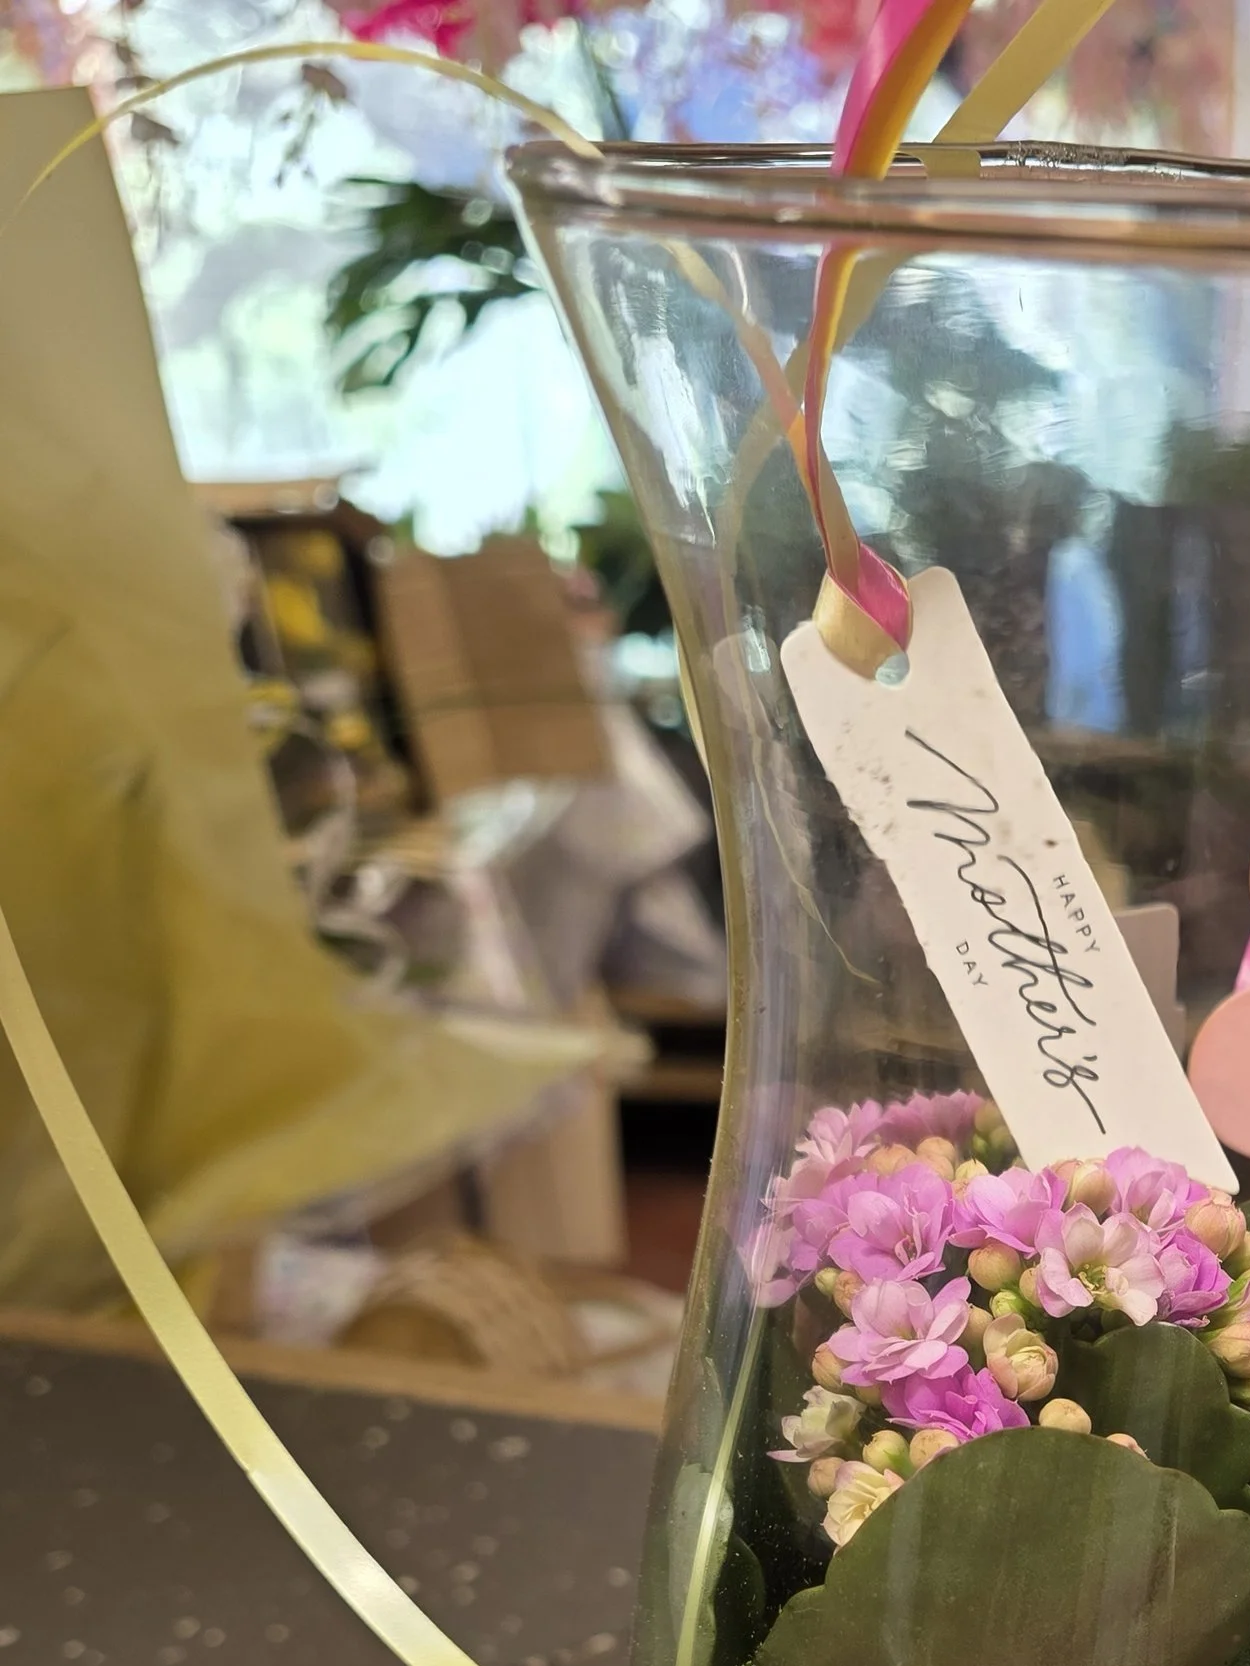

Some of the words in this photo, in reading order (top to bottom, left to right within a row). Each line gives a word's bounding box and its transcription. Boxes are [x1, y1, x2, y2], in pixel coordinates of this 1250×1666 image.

[904, 728, 1106, 1135] Mother's
[1053, 874, 1100, 953] HAPPY
[956, 941, 988, 987] DAY
